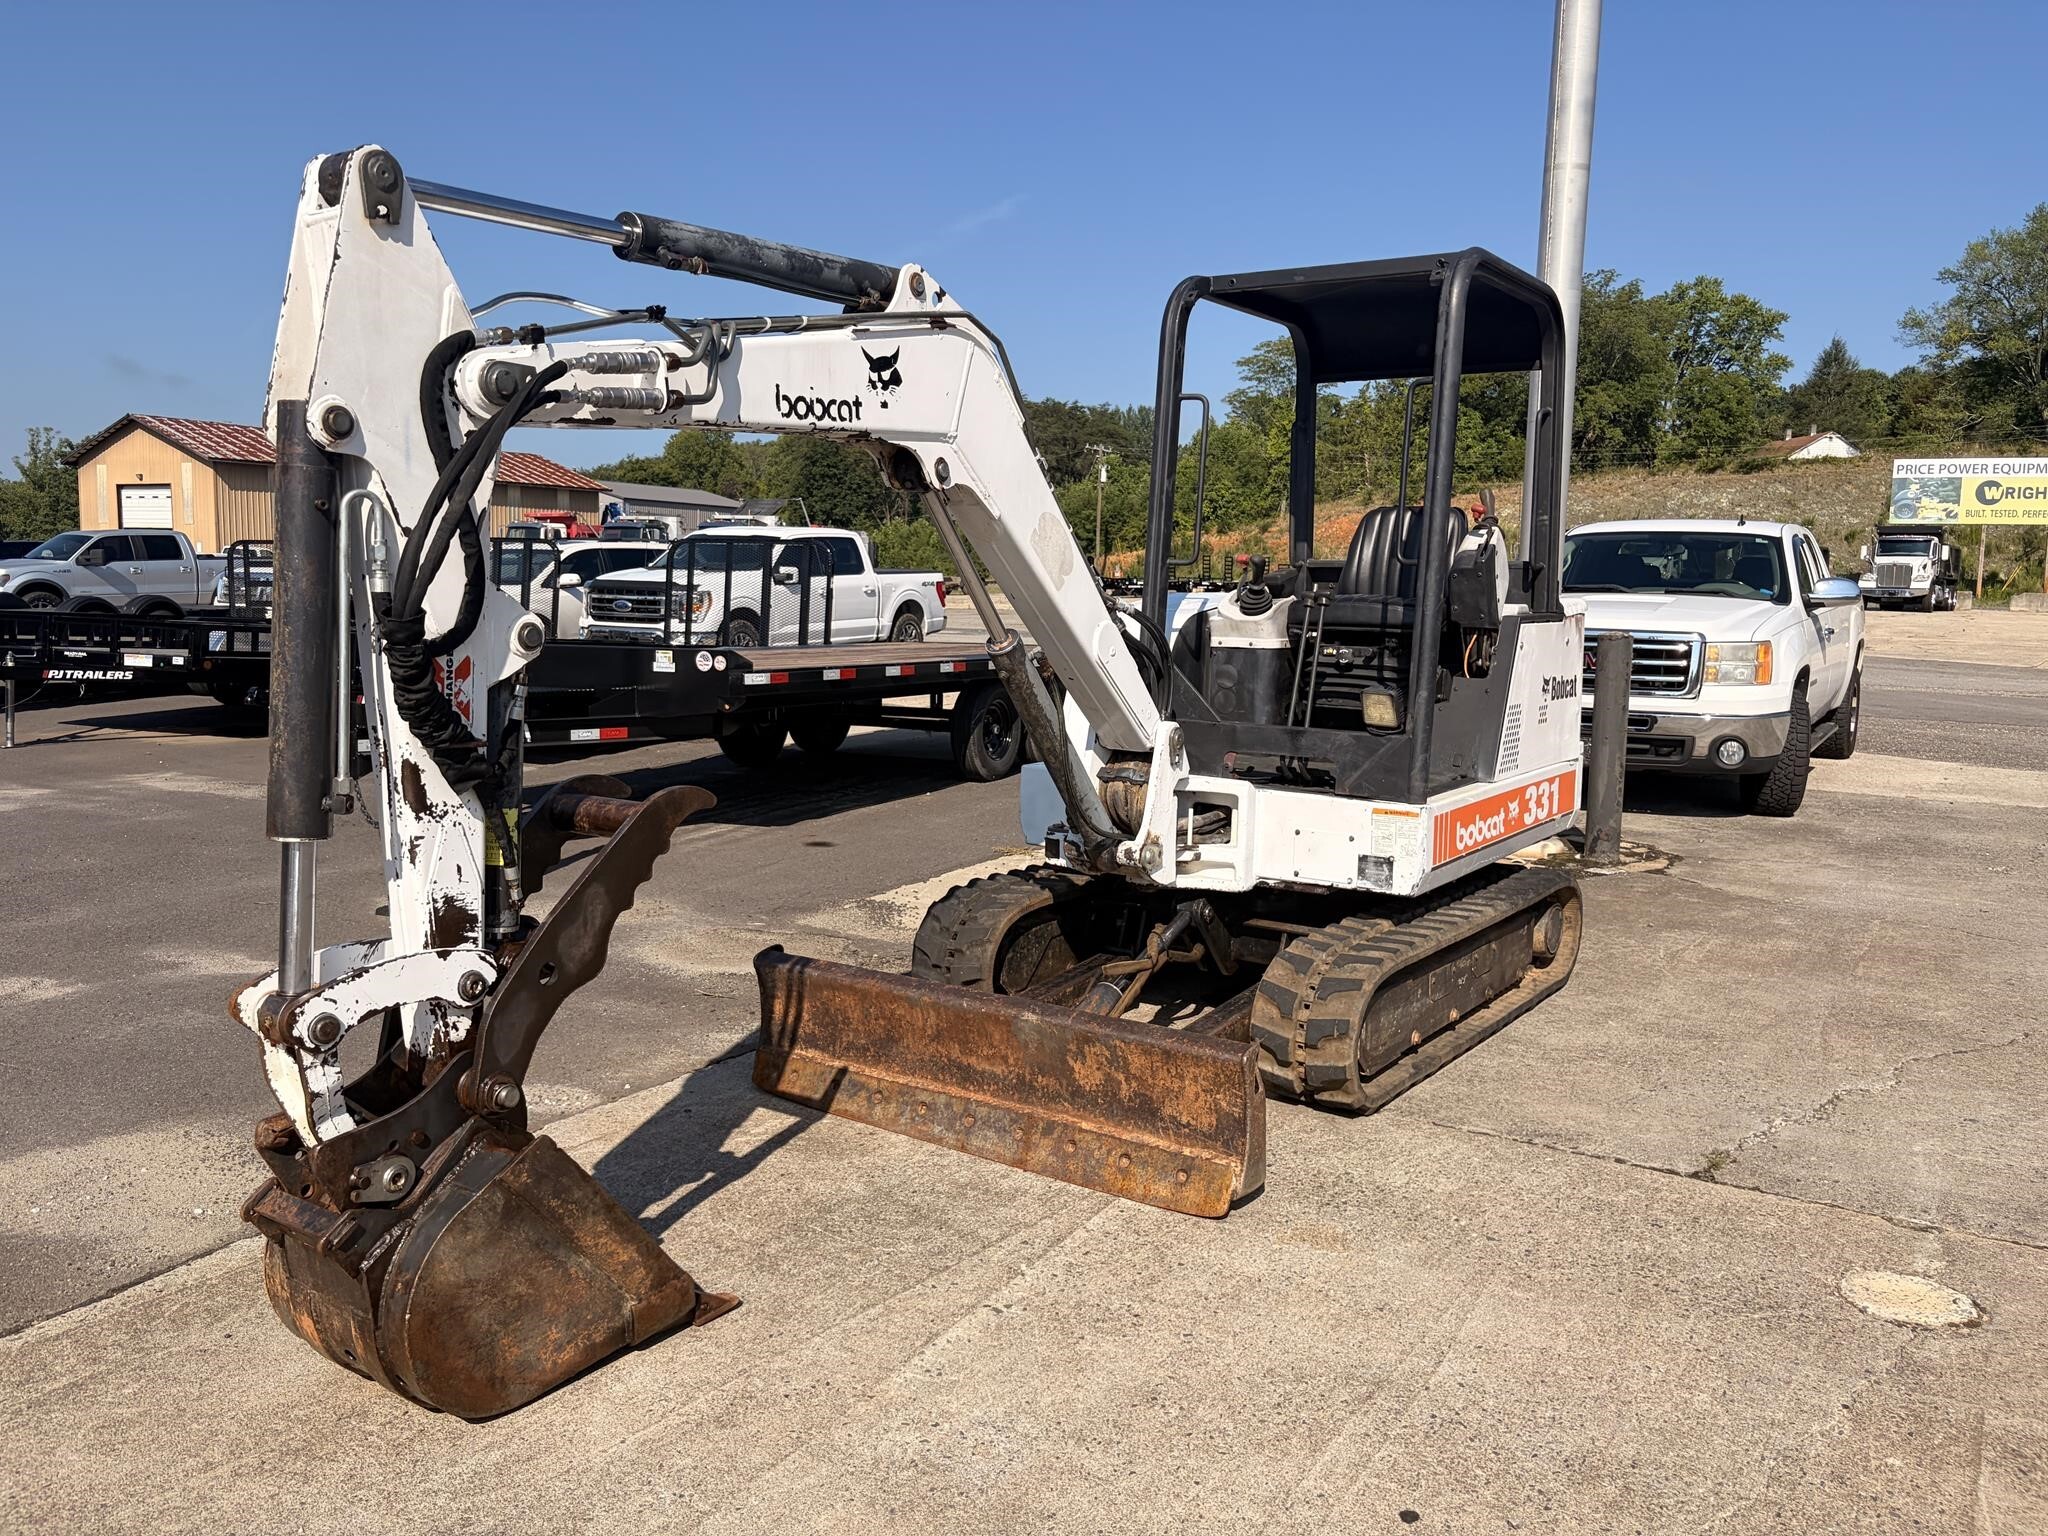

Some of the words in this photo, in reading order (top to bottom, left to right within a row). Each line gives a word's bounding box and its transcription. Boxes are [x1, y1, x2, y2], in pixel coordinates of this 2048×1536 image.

[775, 383, 862, 423] bobcat
[1896, 464, 1935, 475] PRICE
[1938, 463, 1989, 474] POWER
[1992, 463, 2048, 475] EQUIPM
[2022, 509, 2048, 518] PERFE
[64, 670, 134, 680] TRAILERS
[1551, 674, 1577, 701] Bobcat
[1455, 807, 1505, 851] bobcat
[1523, 777, 1560, 826] 331
